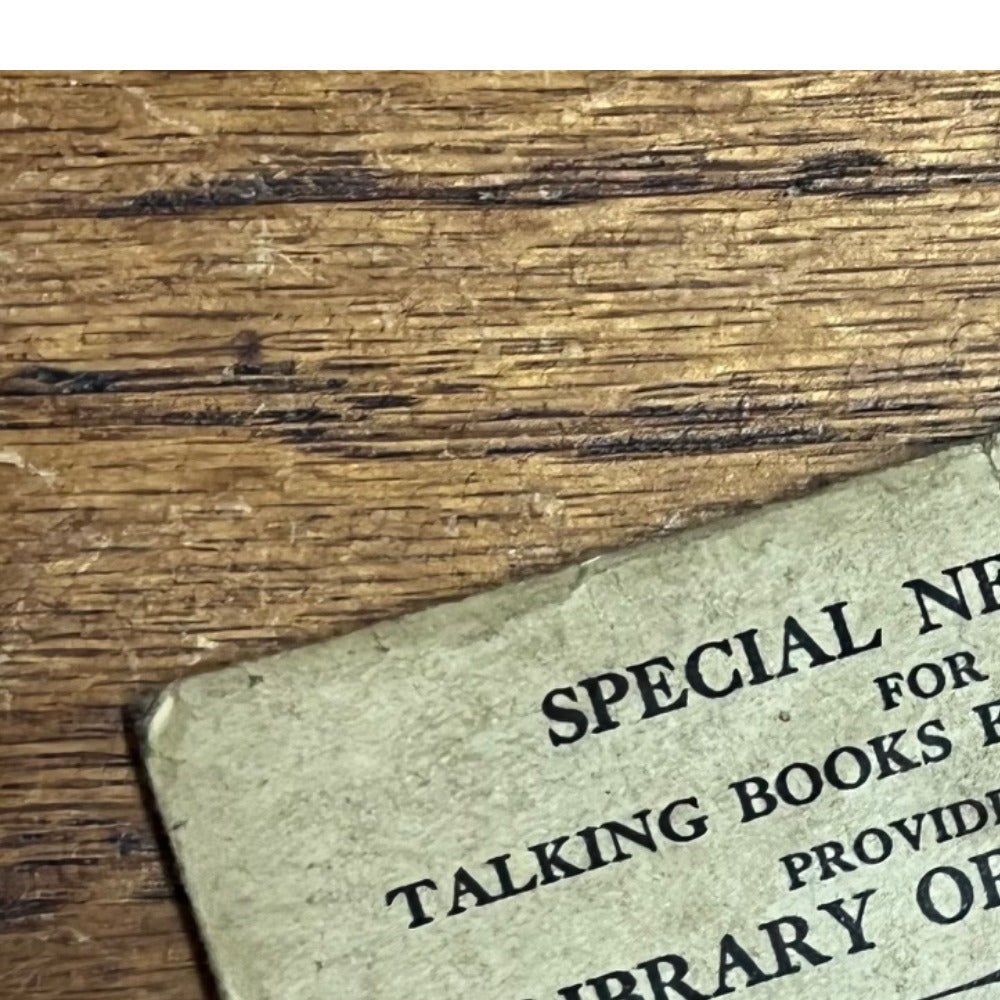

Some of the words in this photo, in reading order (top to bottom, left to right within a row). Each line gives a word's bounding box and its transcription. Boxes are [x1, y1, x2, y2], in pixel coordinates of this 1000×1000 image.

[541, 598, 883, 747] SPECIAL
[873, 651, 988, 711] FOR
[385, 797, 710, 929] TALKING
[731, 720, 953, 823] BOOKS
